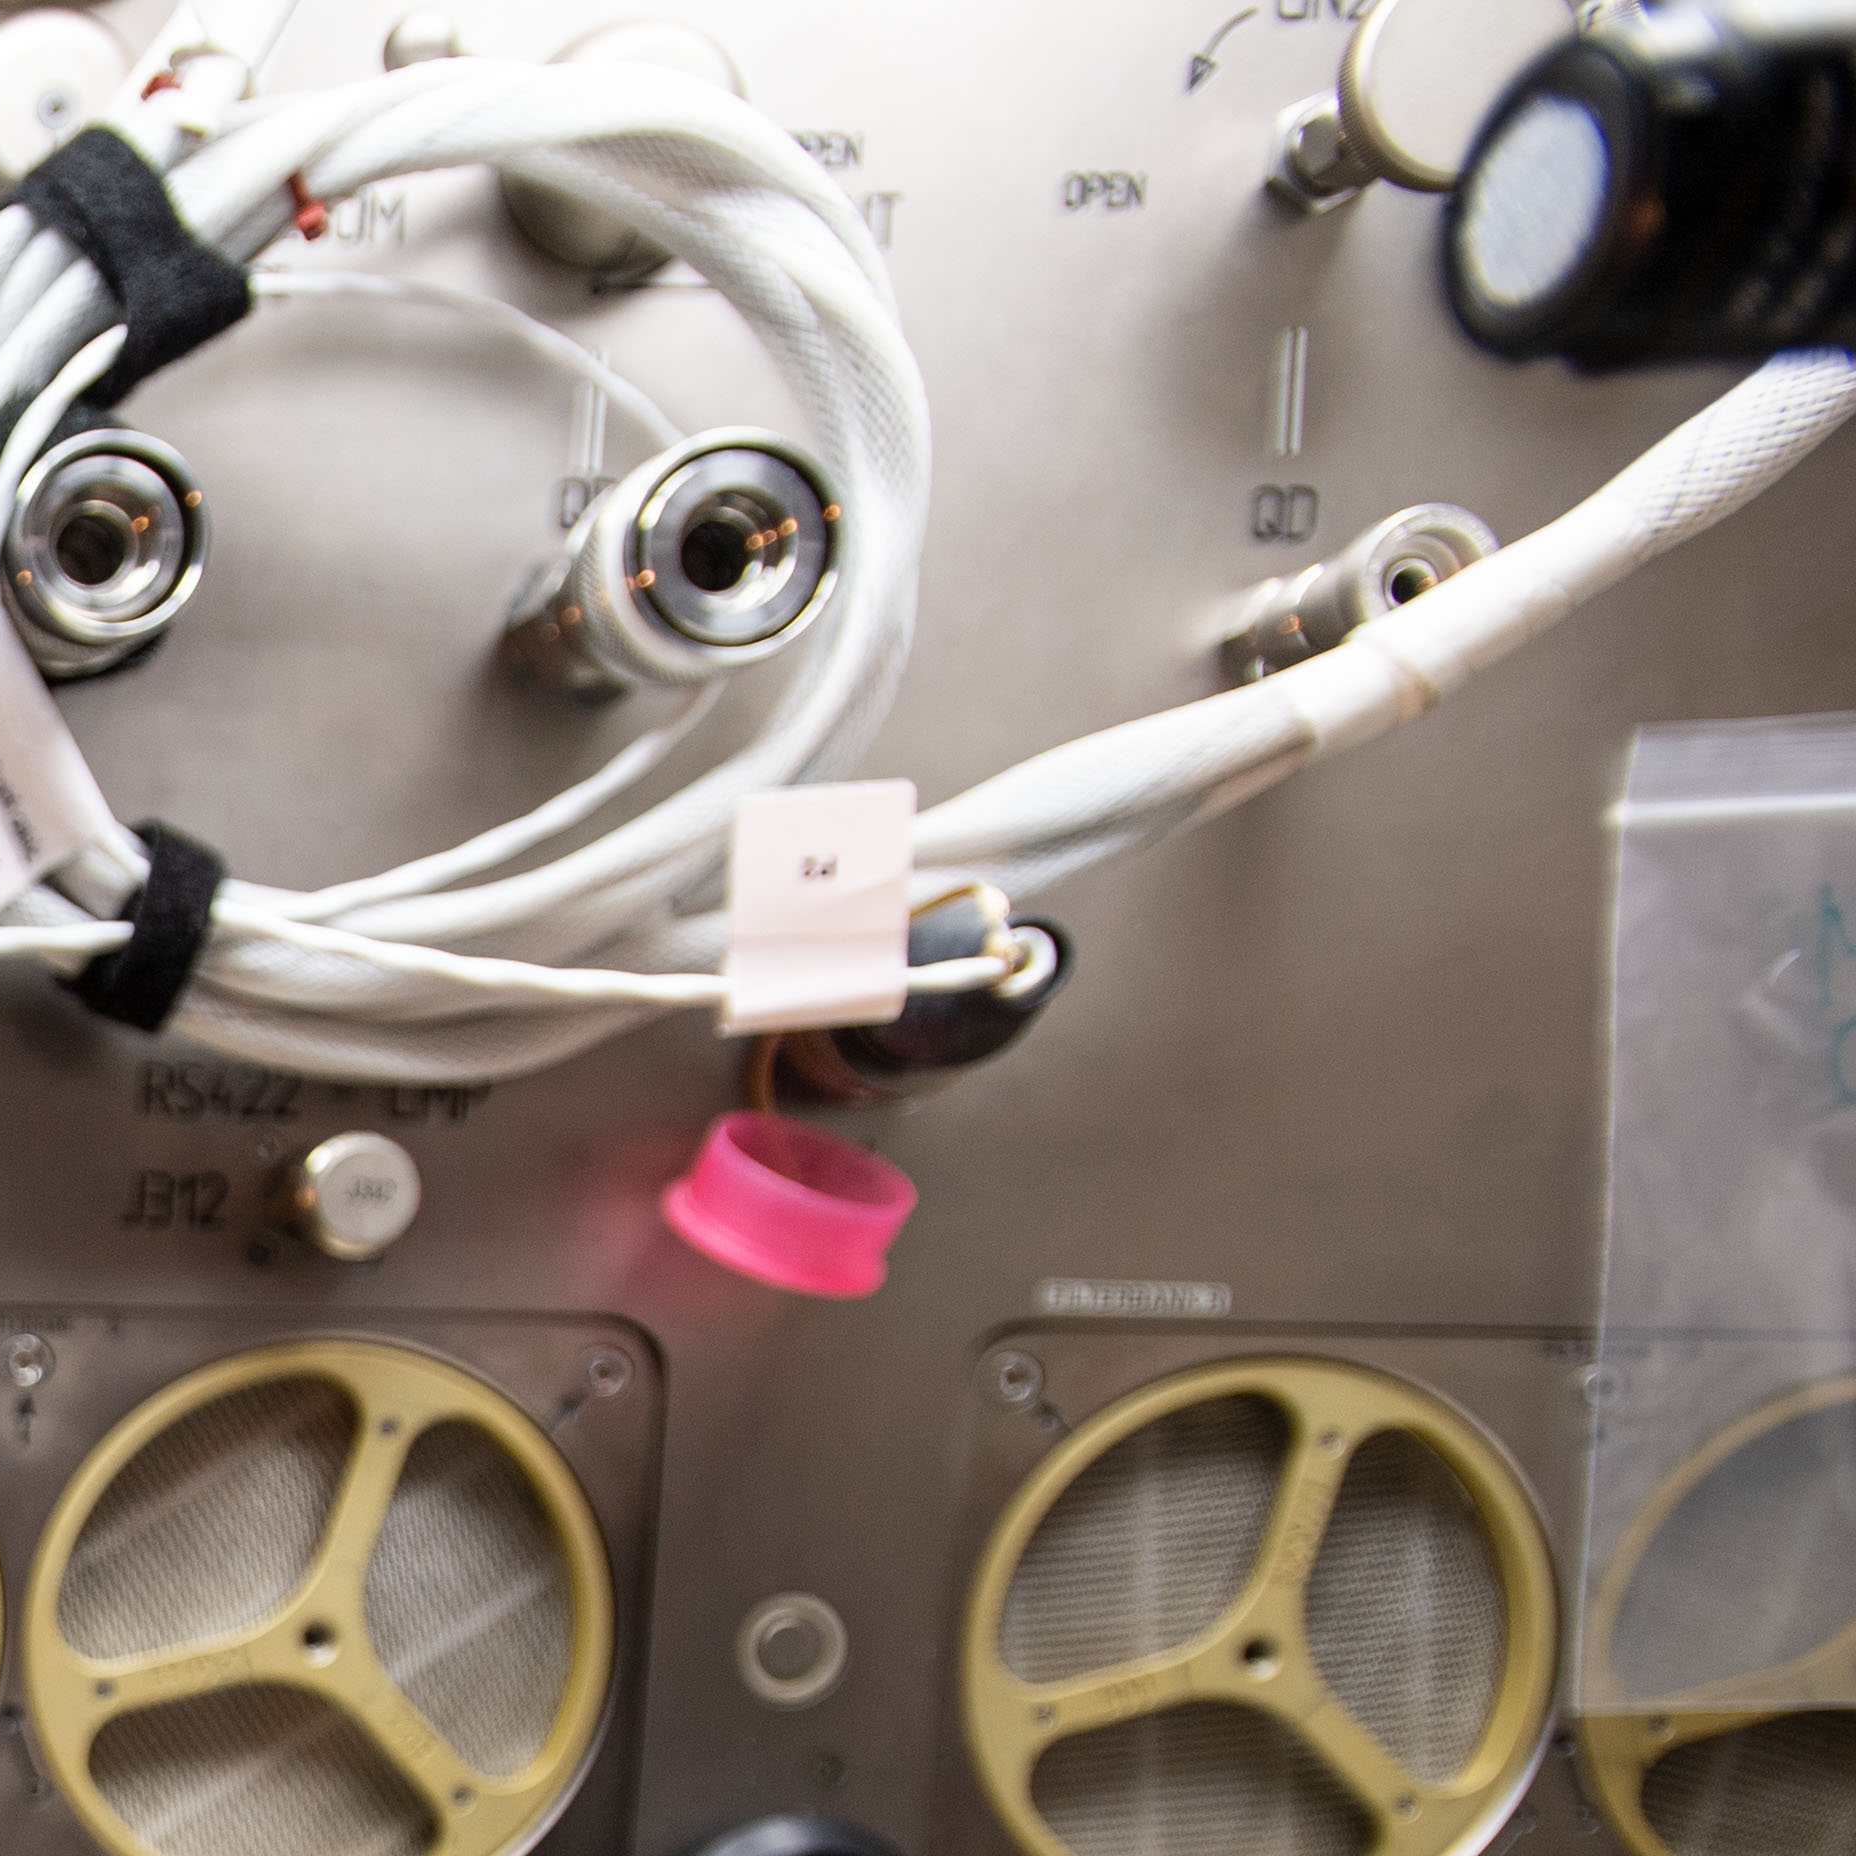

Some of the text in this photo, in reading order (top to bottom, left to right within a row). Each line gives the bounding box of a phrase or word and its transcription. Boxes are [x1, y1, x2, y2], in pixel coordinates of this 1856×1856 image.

[1061, 170, 1150, 209] OPEN
[1252, 483, 1320, 543] QD
[139, 1061, 300, 1119] RS422
